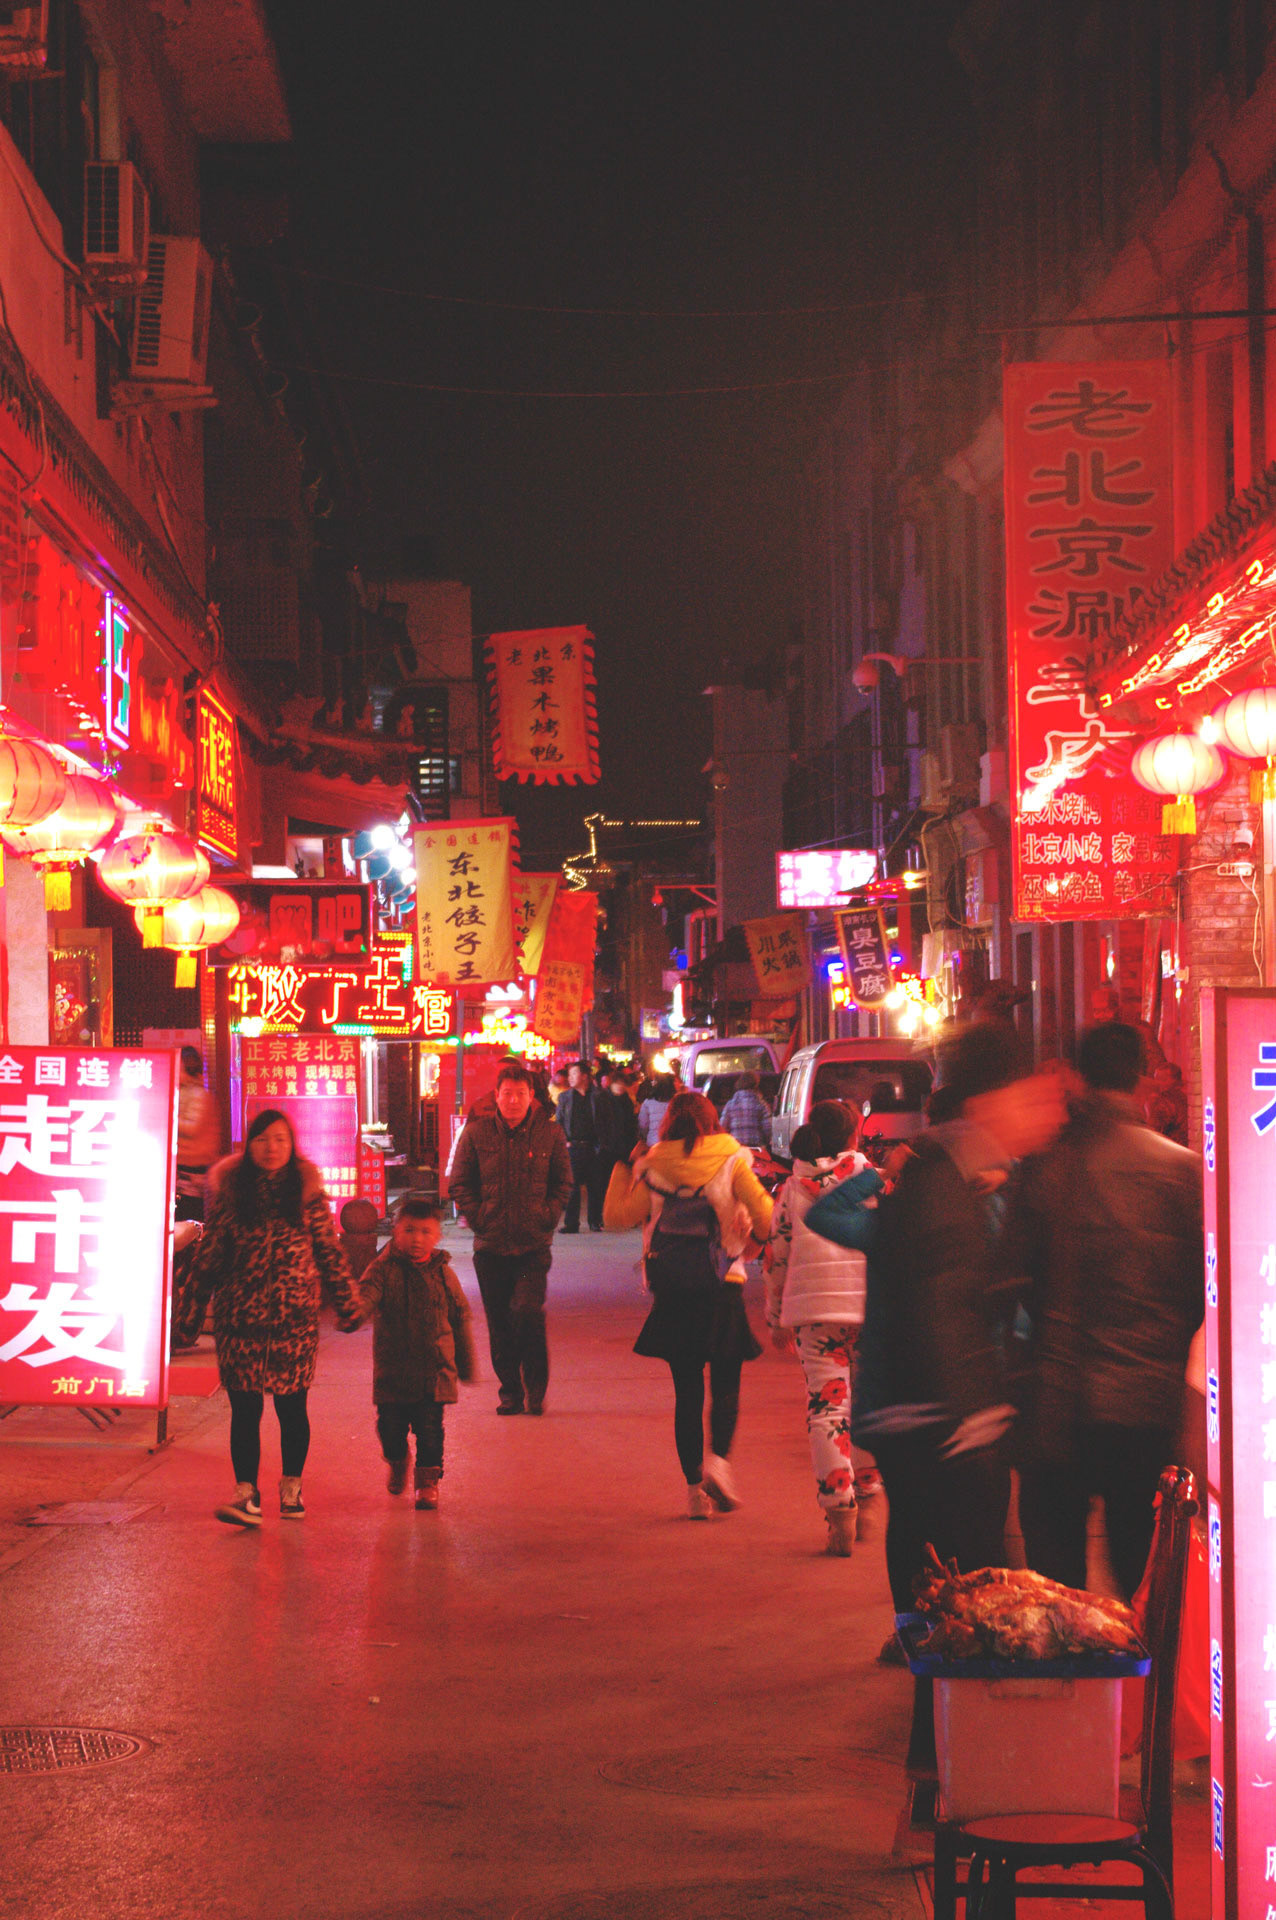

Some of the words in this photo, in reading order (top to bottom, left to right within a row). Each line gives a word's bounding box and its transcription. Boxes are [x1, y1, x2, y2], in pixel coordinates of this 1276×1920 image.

[505, 643, 577, 666] 老北京
[527, 666, 565, 762] 果木烤鸭
[424, 831, 501, 849] 全国连锁
[1022, 832, 1102, 864] 北京小吃
[1112, 832, 1172, 863] 家常菜
[1022, 871, 1104, 903] 巫山烤鱼
[1113, 871, 1173, 904] 羊蝎子
[270, 894, 363, 954] 网吧
[446, 851, 487, 981] 东北饺子王
[421, 911, 436, 973] 老北京小吃
[850, 927, 886, 996] 臭豆腐
[246, 1040, 355, 1061] 正宗老北京
[0, 1056, 153, 1088] 全国连锁
[246, 1065, 297, 1079] 果木烤鸭
[0, 1094, 140, 1369] 超市发
[51, 1376, 149, 1397] 前门店
